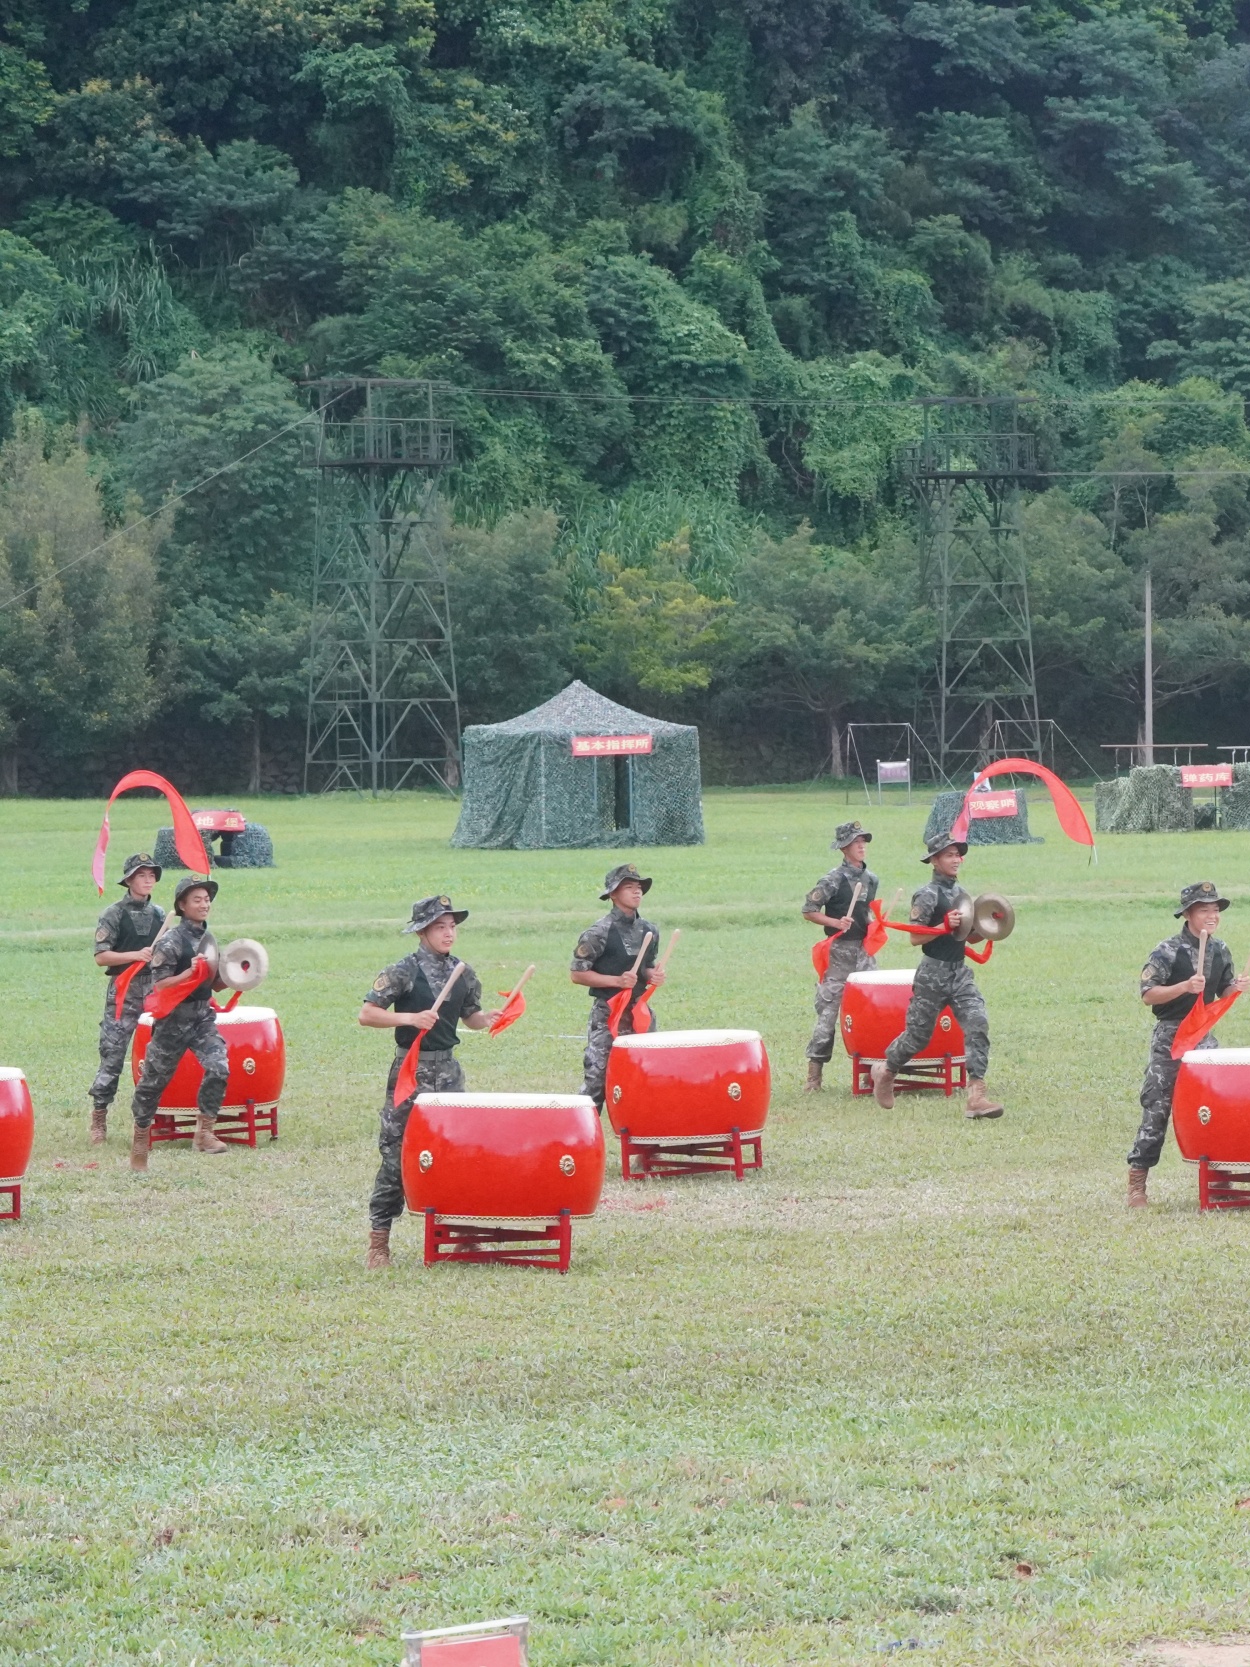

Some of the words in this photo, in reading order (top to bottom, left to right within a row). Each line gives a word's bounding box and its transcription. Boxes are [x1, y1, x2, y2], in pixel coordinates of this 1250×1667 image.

[575, 738, 650, 752] 基本指挥所
[1183, 772, 1231, 783] 弹药库
[969, 799, 1015, 811] 观察哨
